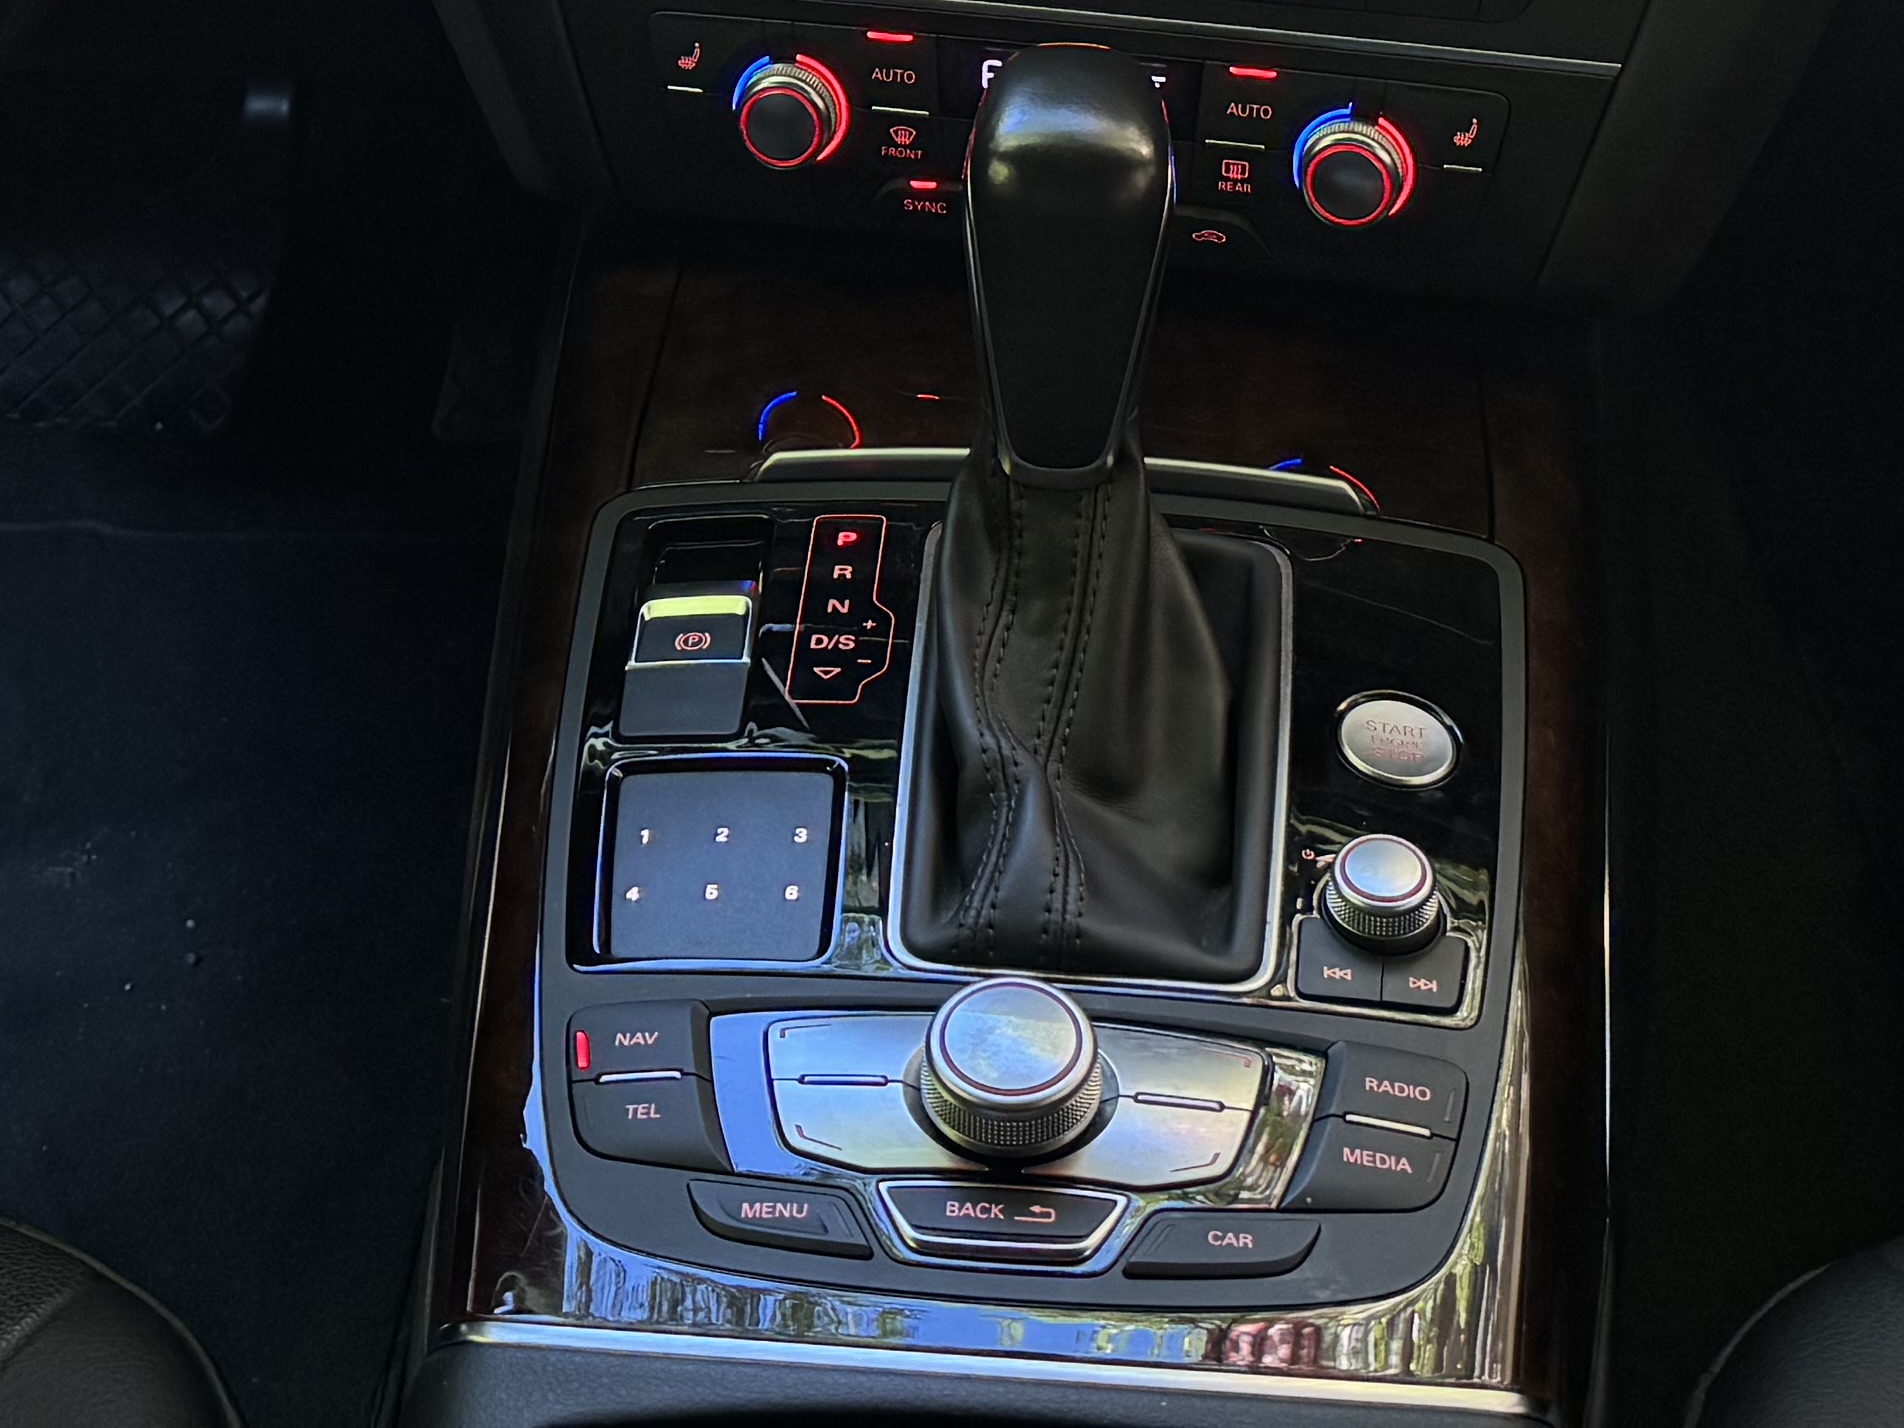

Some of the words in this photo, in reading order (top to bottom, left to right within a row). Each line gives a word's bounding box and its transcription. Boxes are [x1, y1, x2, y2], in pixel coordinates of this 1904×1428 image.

[871, 67, 917, 85] AUTO
[1226, 101, 1273, 121] AUTO
[880, 145, 923, 161] FRONT
[1217, 179, 1253, 195] REAR
[903, 198, 948, 215] SYNC
[837, 531, 858, 546] P
[833, 565, 853, 579] R
[827, 599, 850, 614] N
[809, 634, 856, 651] D/S
[1365, 719, 1428, 739] START
[1373, 748, 1425, 762] STOP
[639, 828, 651, 845] 1
[715, 827, 730, 843] 2
[793, 828, 809, 844] 3
[625, 886, 641, 902] 4
[704, 884, 720, 900] 5
[784, 885, 799, 901] 6
[614, 1030, 659, 1046] NAV
[1364, 1075, 1432, 1103] RADIO
[624, 1103, 662, 1119] TEL
[1342, 1146, 1413, 1174] MEDIA
[740, 1202, 810, 1219] MENU
[945, 1200, 1005, 1220] BACK
[1206, 1230, 1254, 1249] CAR
